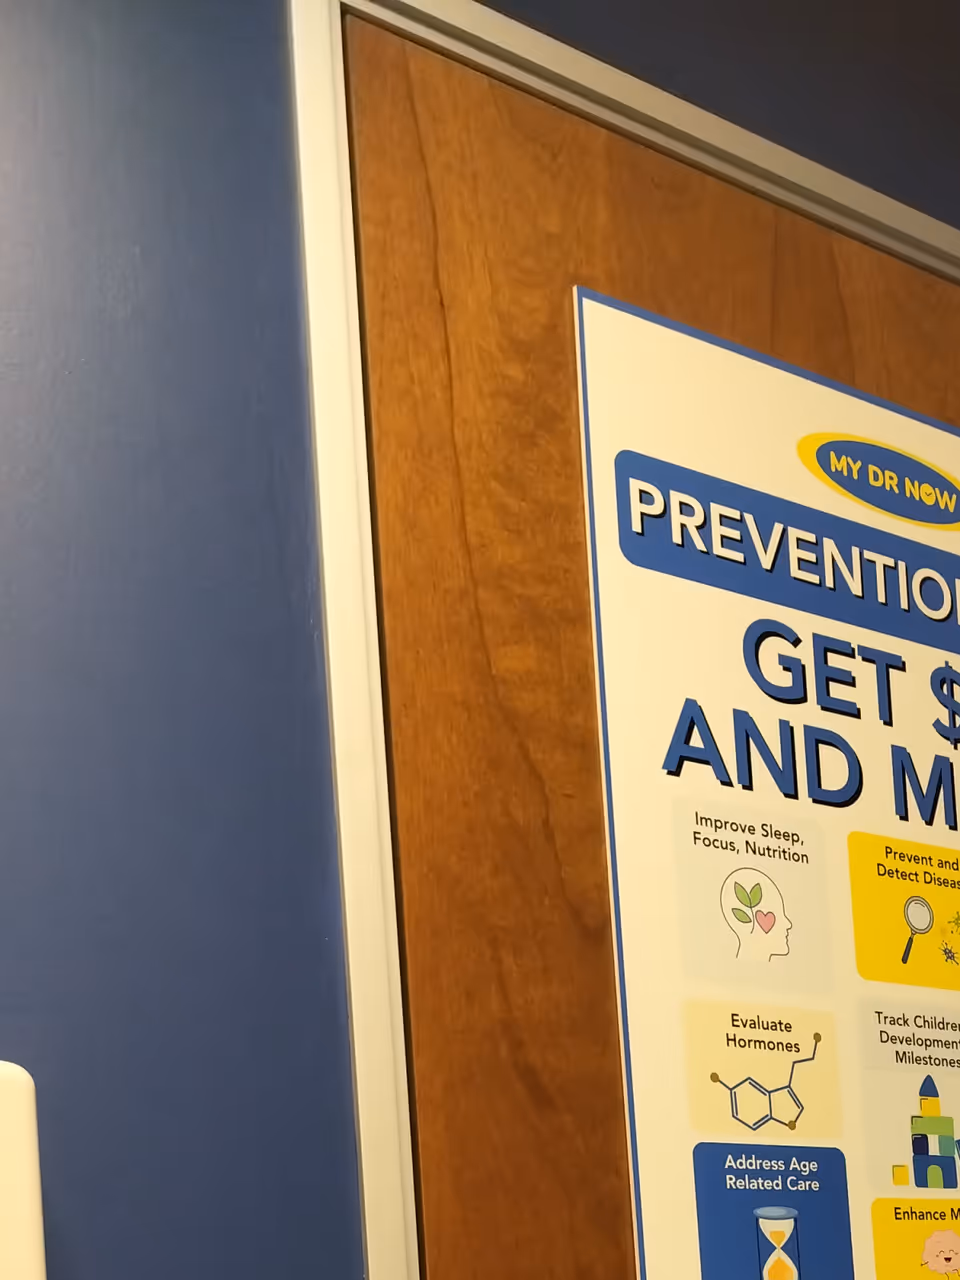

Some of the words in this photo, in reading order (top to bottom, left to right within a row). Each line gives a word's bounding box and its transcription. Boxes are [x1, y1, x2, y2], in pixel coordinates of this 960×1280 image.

[829, 450, 862, 479] MY
[867, 464, 898, 493] DR
[904, 476, 957, 512] NOW
[742, 618, 906, 727] GET
[661, 697, 863, 808] AND
[695, 811, 755, 835] Improve
[760, 823, 803, 846] Sleep,
[692, 830, 740, 855] Focus,
[745, 840, 808, 864] Nutrition
[884, 845, 933, 866] Prevent
[937, 858, 959, 871] and
[876, 862, 919, 883] Detect
[731, 1013, 792, 1032] Evaluate
[874, 1010, 910, 1026] Track
[725, 1032, 800, 1053] Hormones
[895, 1050, 960, 1068] Milestones
[724, 1154, 785, 1170] Address
[789, 1157, 818, 1175] Age
[725, 1174, 782, 1190] Related
[786, 1176, 819, 1190] Care
[894, 1206, 946, 1220] Enhance
